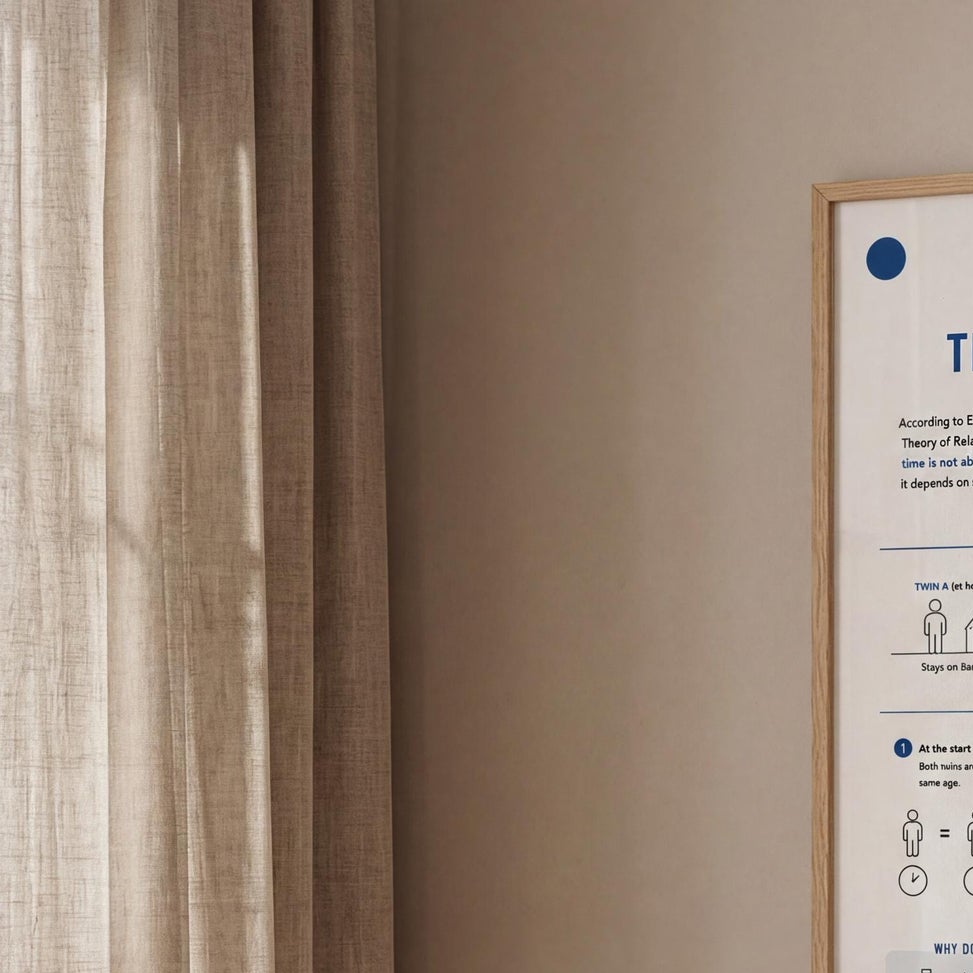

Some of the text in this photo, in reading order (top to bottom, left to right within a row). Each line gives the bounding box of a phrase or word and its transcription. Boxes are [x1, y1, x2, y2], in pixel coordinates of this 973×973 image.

[898, 416, 964, 429] According to
[901, 438, 937, 450] Theory
[939, 436, 951, 447] of
[901, 458, 925, 468] time
[928, 457, 937, 467] is
[939, 457, 958, 467] not
[900, 478, 908, 488] it
[910, 476, 954, 491] depends
[914, 582, 940, 590] TWIN
[941, 582, 949, 590] A
[921, 662, 944, 674] Stays
[918, 744, 930, 753] At
[931, 744, 947, 753] the
[918, 761, 938, 770] Both
[942, 780, 960, 789] age.
[933, 943, 957, 954] WHY
